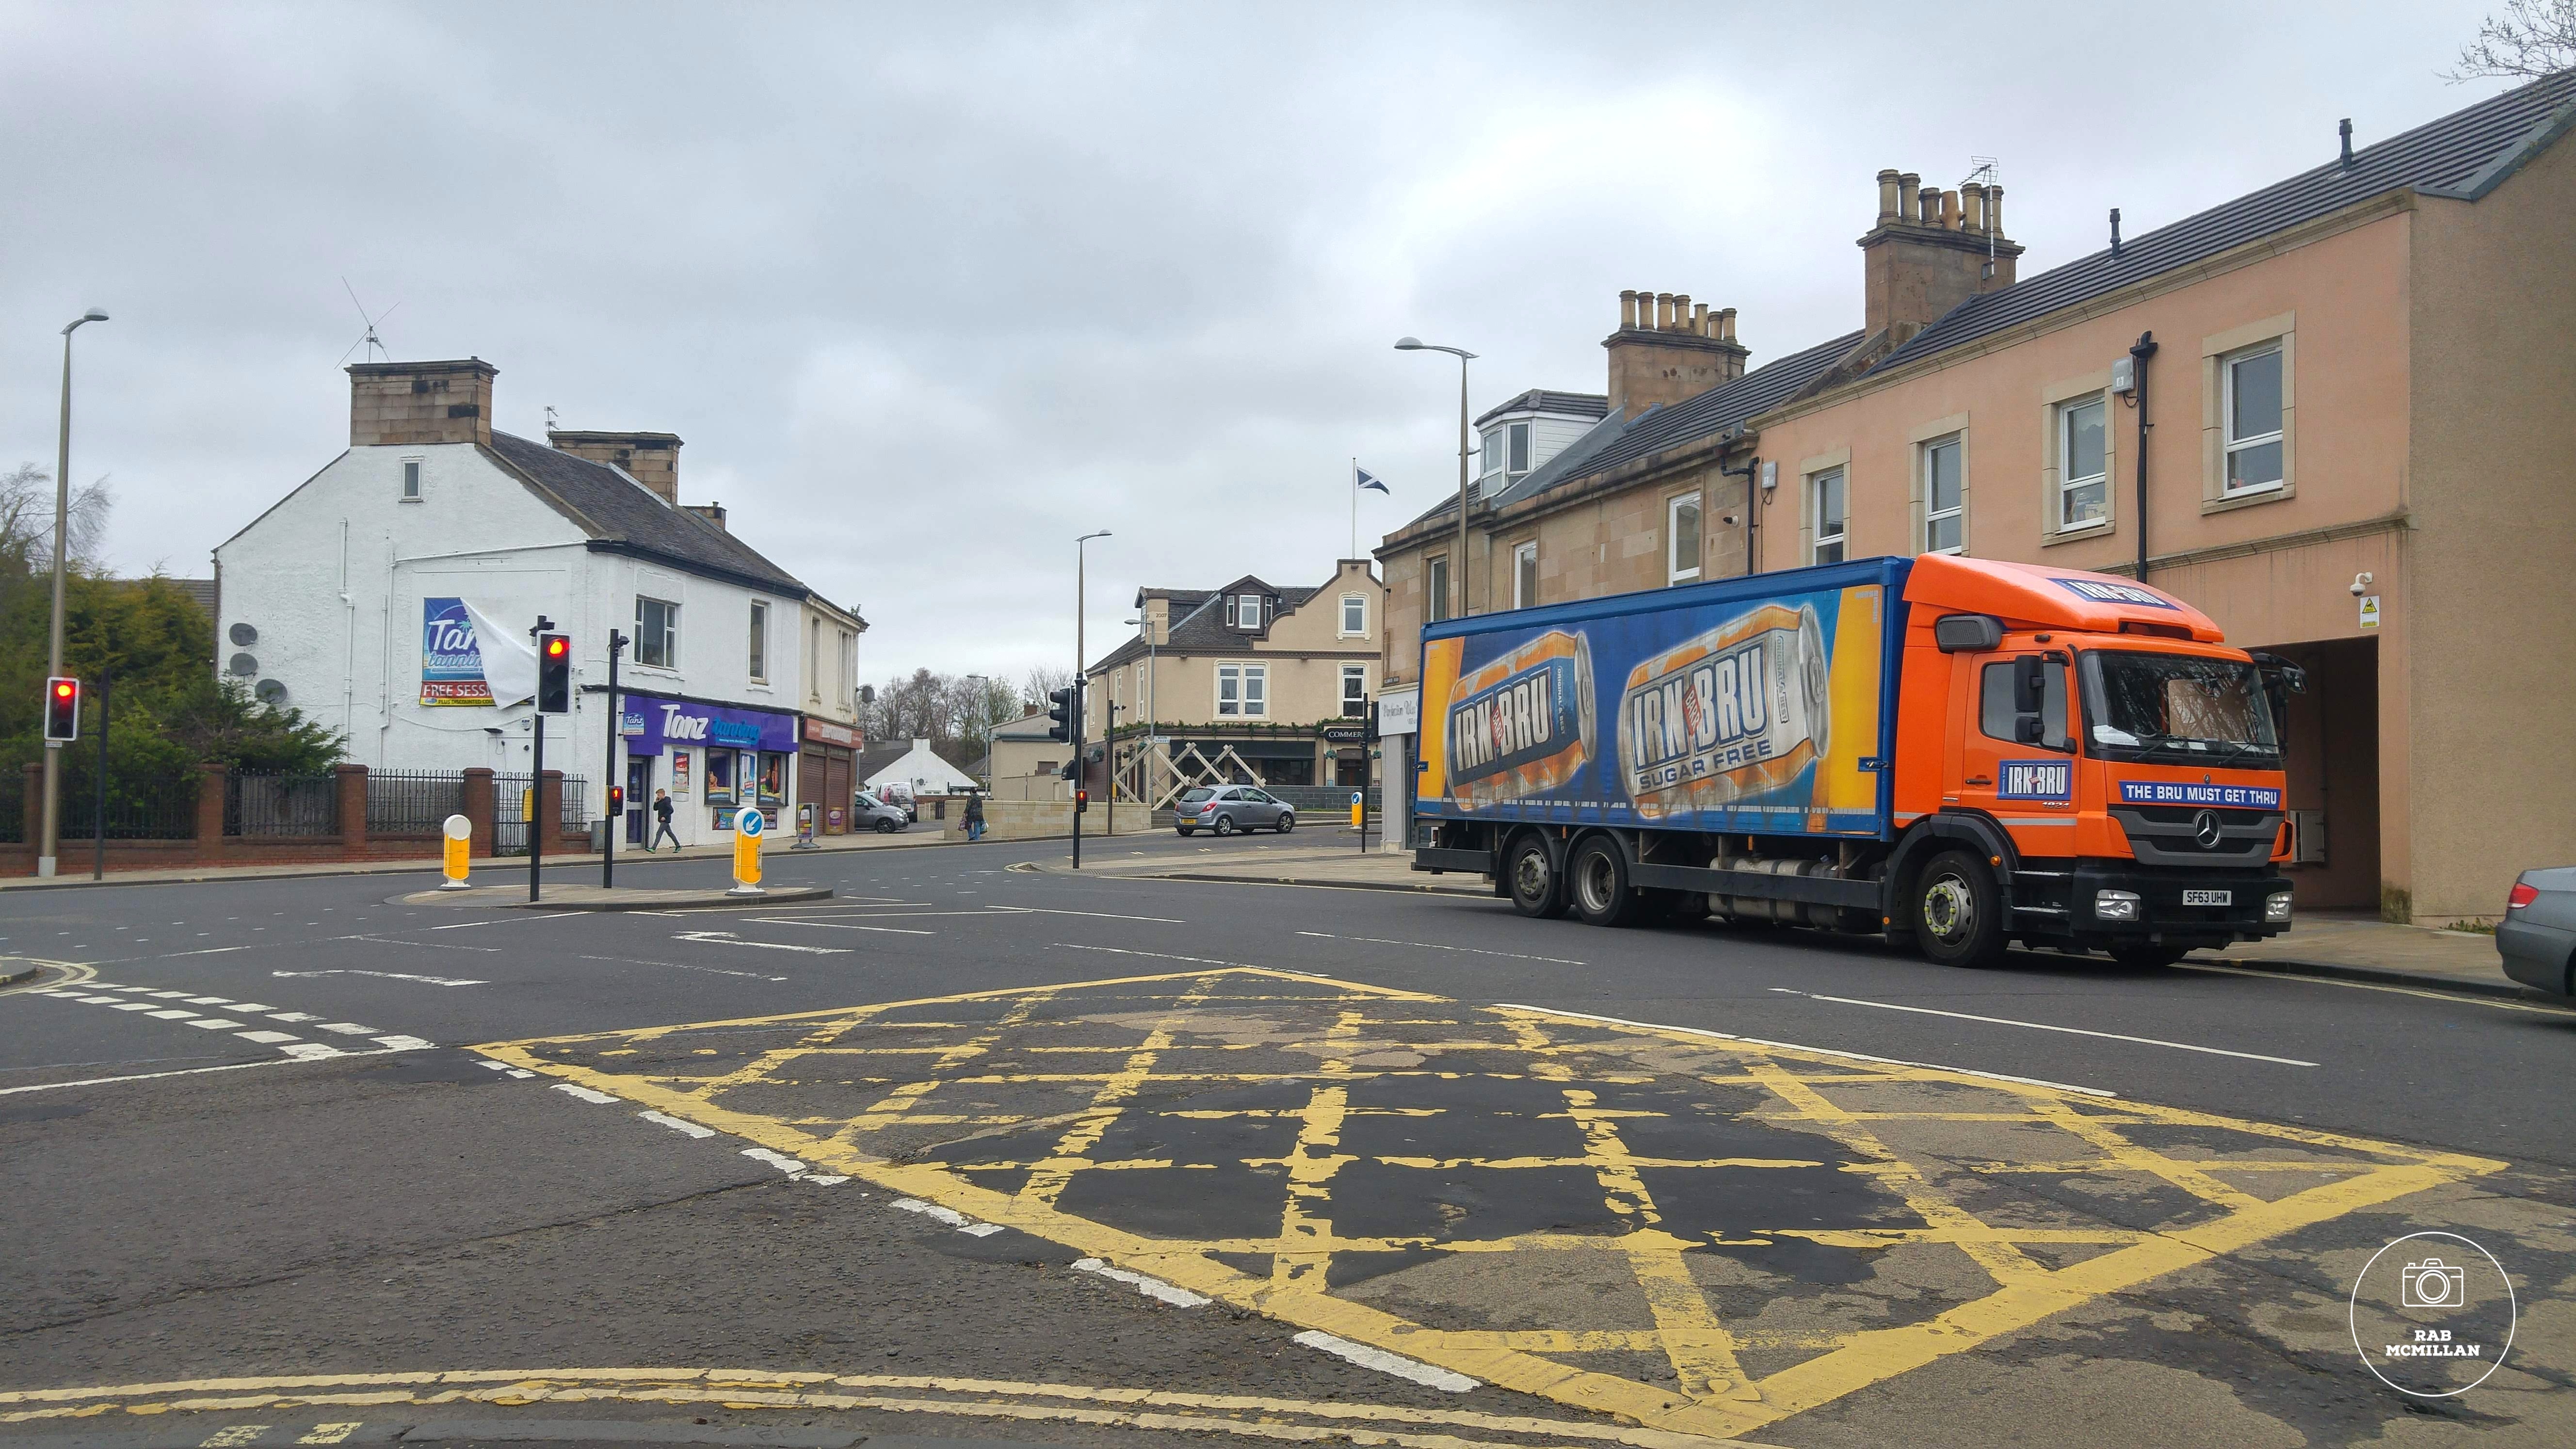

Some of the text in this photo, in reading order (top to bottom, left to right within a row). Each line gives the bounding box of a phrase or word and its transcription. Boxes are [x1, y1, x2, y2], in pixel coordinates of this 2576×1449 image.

[423, 685, 453, 696] FREE
[1634, 647, 1764, 767] IRN BRU
[660, 704, 760, 741] Tanz tanning
[1455, 675, 1549, 772] IRN BRU
[1492, 710, 1503, 743] BARR
[1686, 690, 1699, 731] BARR
[1640, 739, 1771, 789] SUGAR FREE
[2008, 767, 2033, 794] IRN
[2037, 767, 2066, 794] BRU
[2126, 785, 2277, 805] THE BRU MUST GET THRU
[2187, 892, 2228, 903] SF63 UHW
